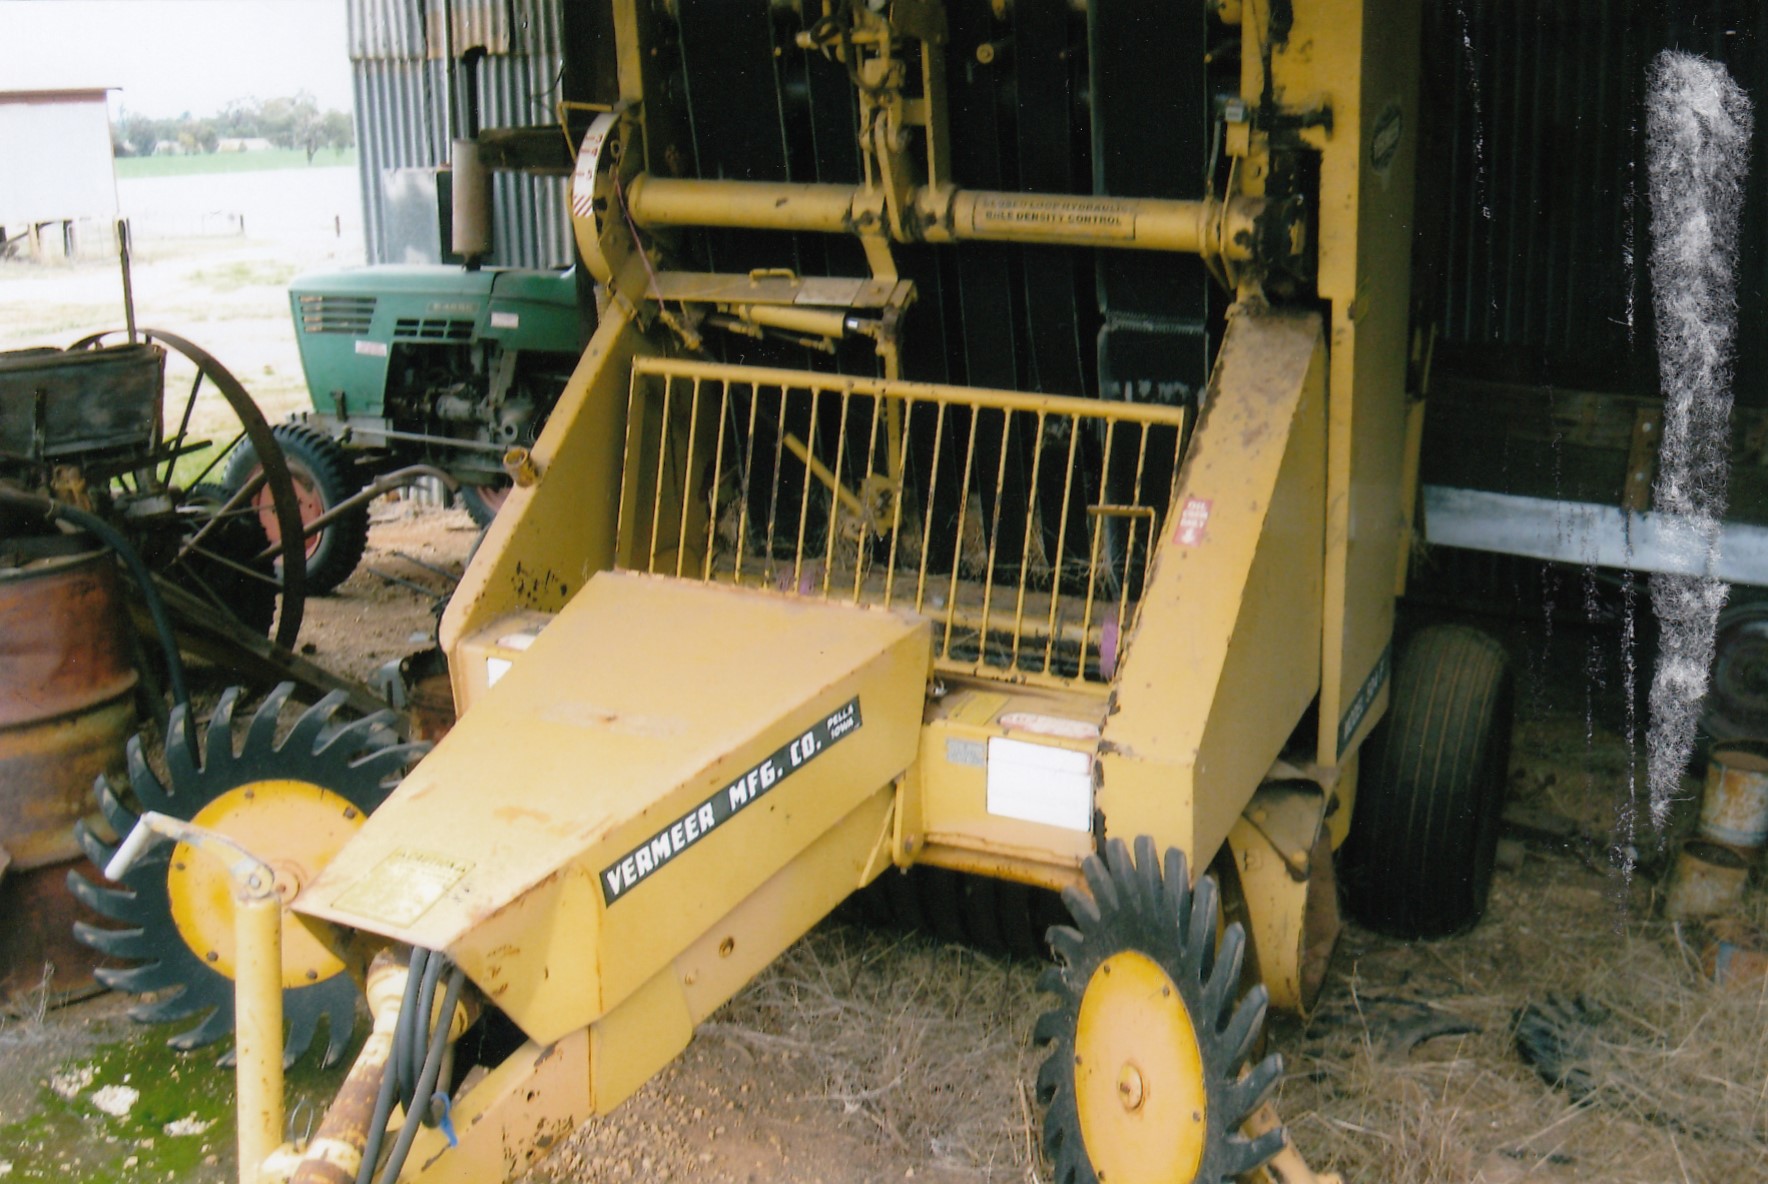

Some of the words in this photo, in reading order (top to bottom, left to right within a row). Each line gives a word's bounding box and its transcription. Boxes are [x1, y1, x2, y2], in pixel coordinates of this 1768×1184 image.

[1016, 211, 1064, 223] DENSITY
[1067, 213, 1122, 226] CONTROL
[826, 704, 854, 730] PELLA
[830, 716, 854, 740] IOWA
[606, 802, 715, 896] VERMEER
[728, 759, 784, 812] MFG.
[790, 731, 823, 767] CO.
